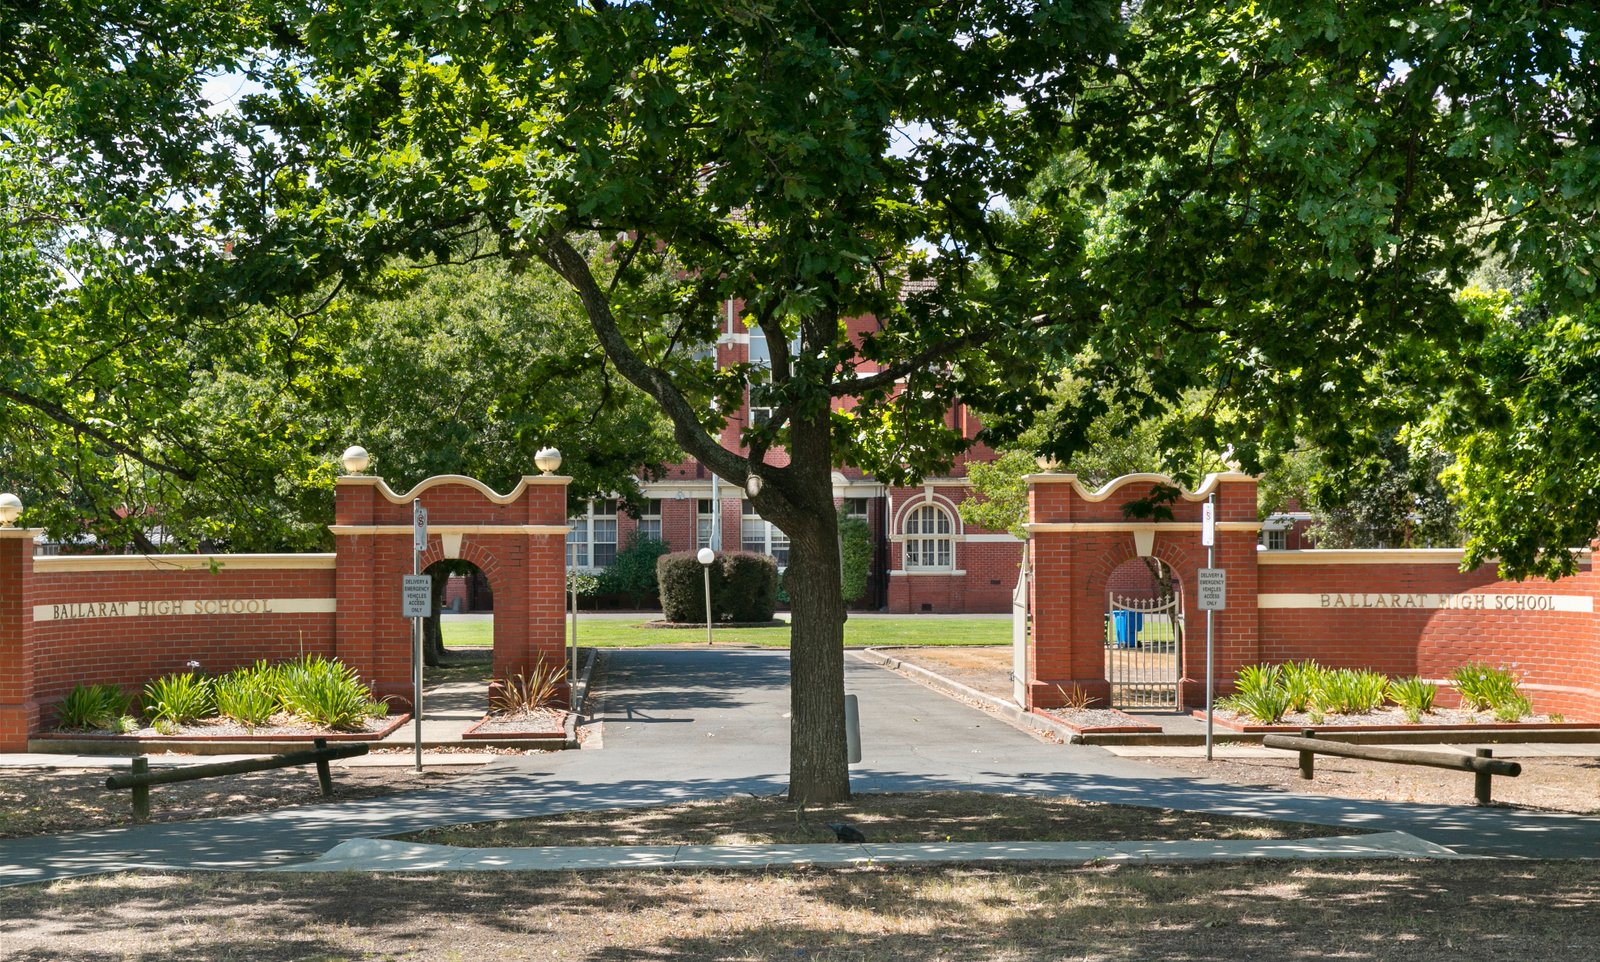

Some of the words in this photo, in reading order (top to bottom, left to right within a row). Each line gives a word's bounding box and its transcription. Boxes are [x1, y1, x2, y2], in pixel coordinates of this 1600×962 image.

[53, 602, 128, 620] BALLARAT
[138, 600, 184, 616] HIGH
[194, 599, 273, 615] SCHOOL
[1320, 594, 1428, 608] BALLARAT
[1439, 594, 1486, 609] HIGH
[1495, 595, 1556, 611] SCHOOL
